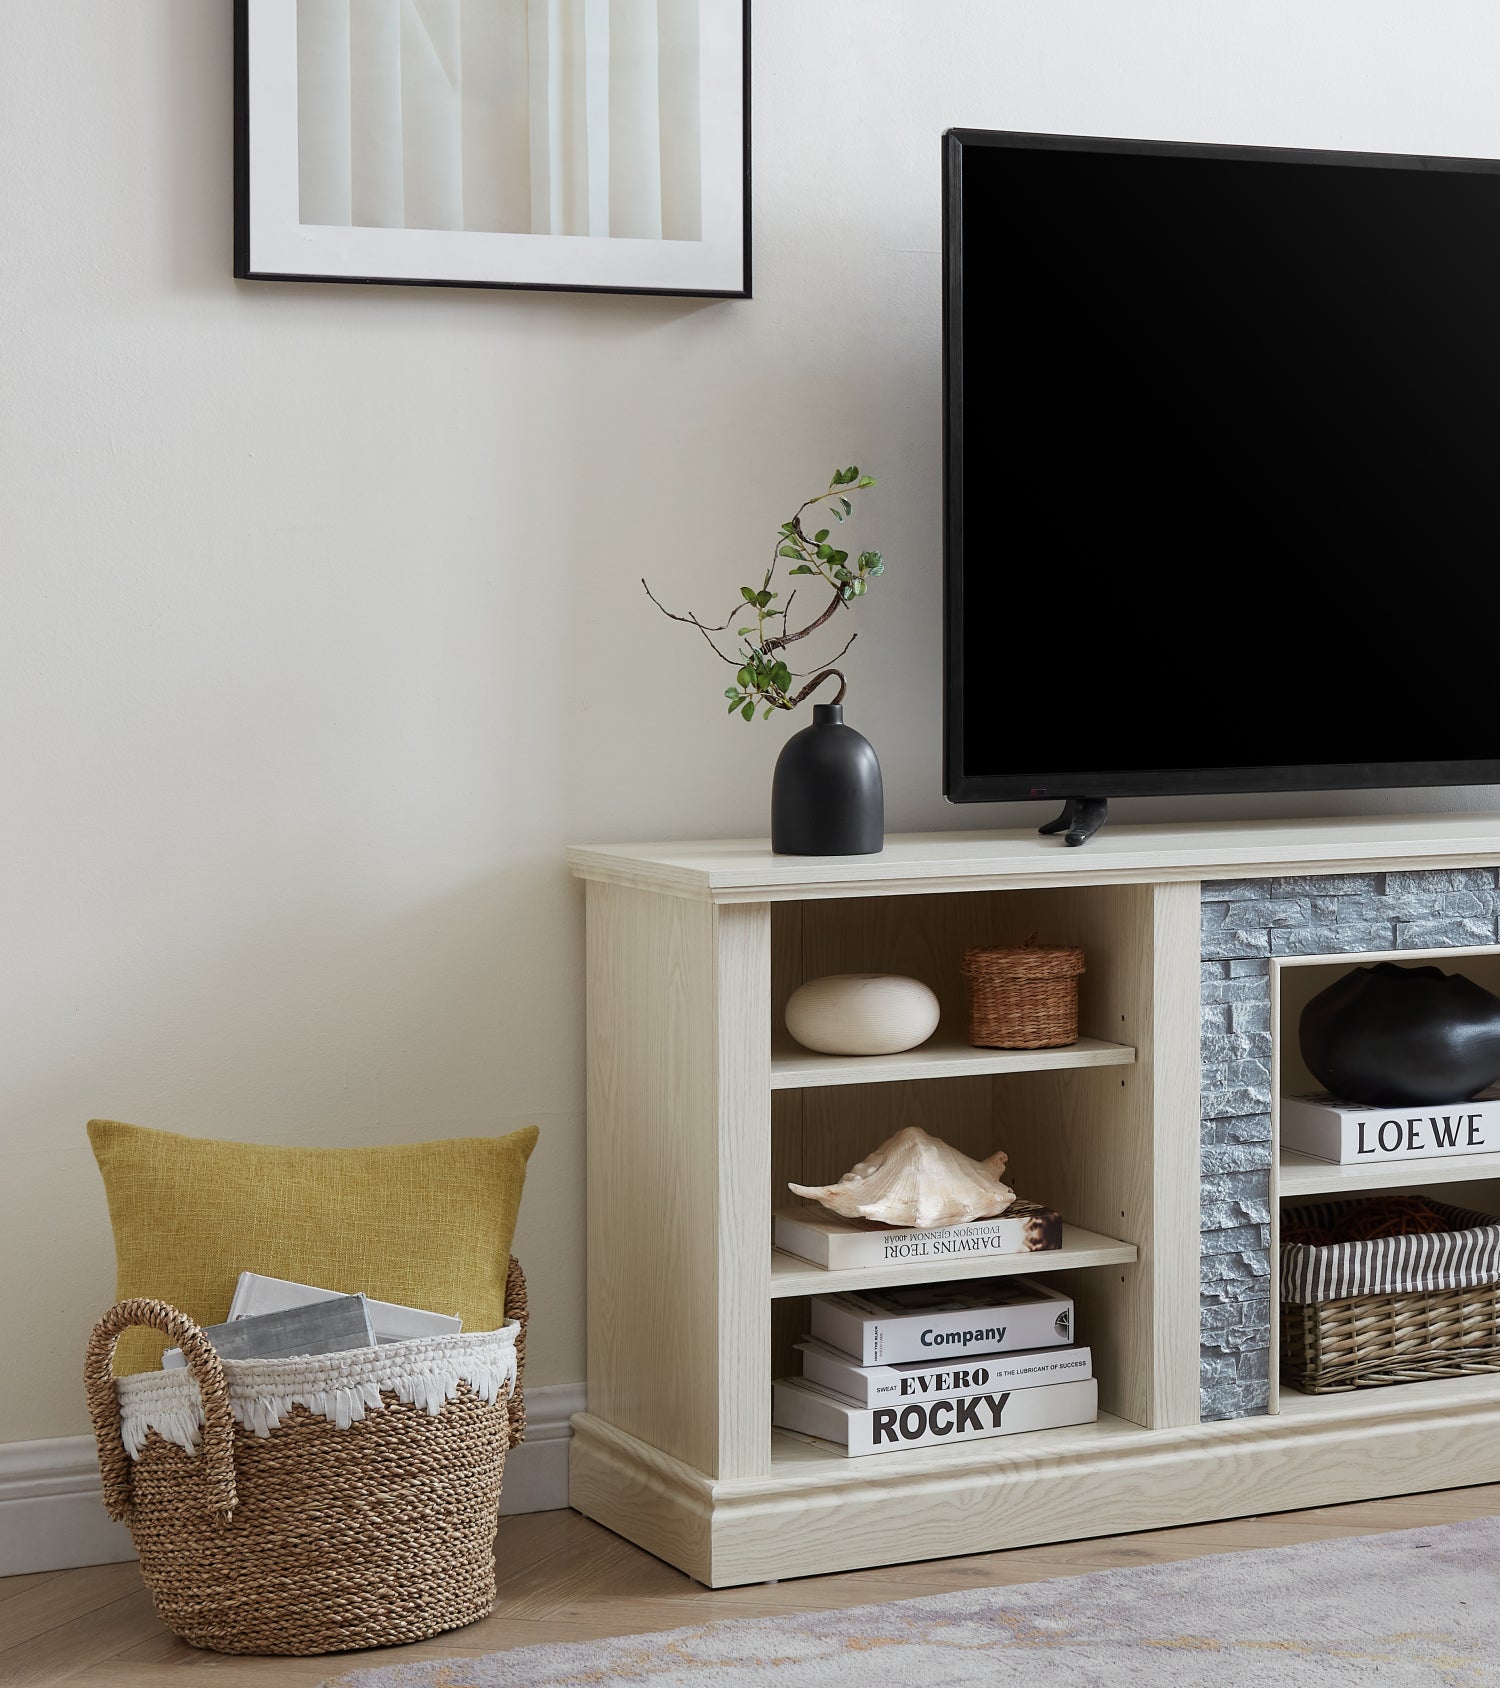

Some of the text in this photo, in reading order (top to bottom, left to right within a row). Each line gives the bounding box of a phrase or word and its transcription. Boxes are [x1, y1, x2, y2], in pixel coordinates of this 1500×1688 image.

[1357, 1113, 1485, 1154] LOEWE
[909, 1228, 951, 1242] GJENNOM
[952, 1225, 1000, 1238] EVOLUSJON
[884, 1235, 1002, 1259] DARWINS TEORI
[920, 1325, 1007, 1347] Company
[876, 1385, 897, 1393] SWEAT
[899, 1367, 990, 1397] EVERO
[1016, 1365, 1049, 1375] LUBRICANT
[1059, 1360, 1087, 1369] SUCCESS
[872, 1392, 1011, 1445] ROCKY
